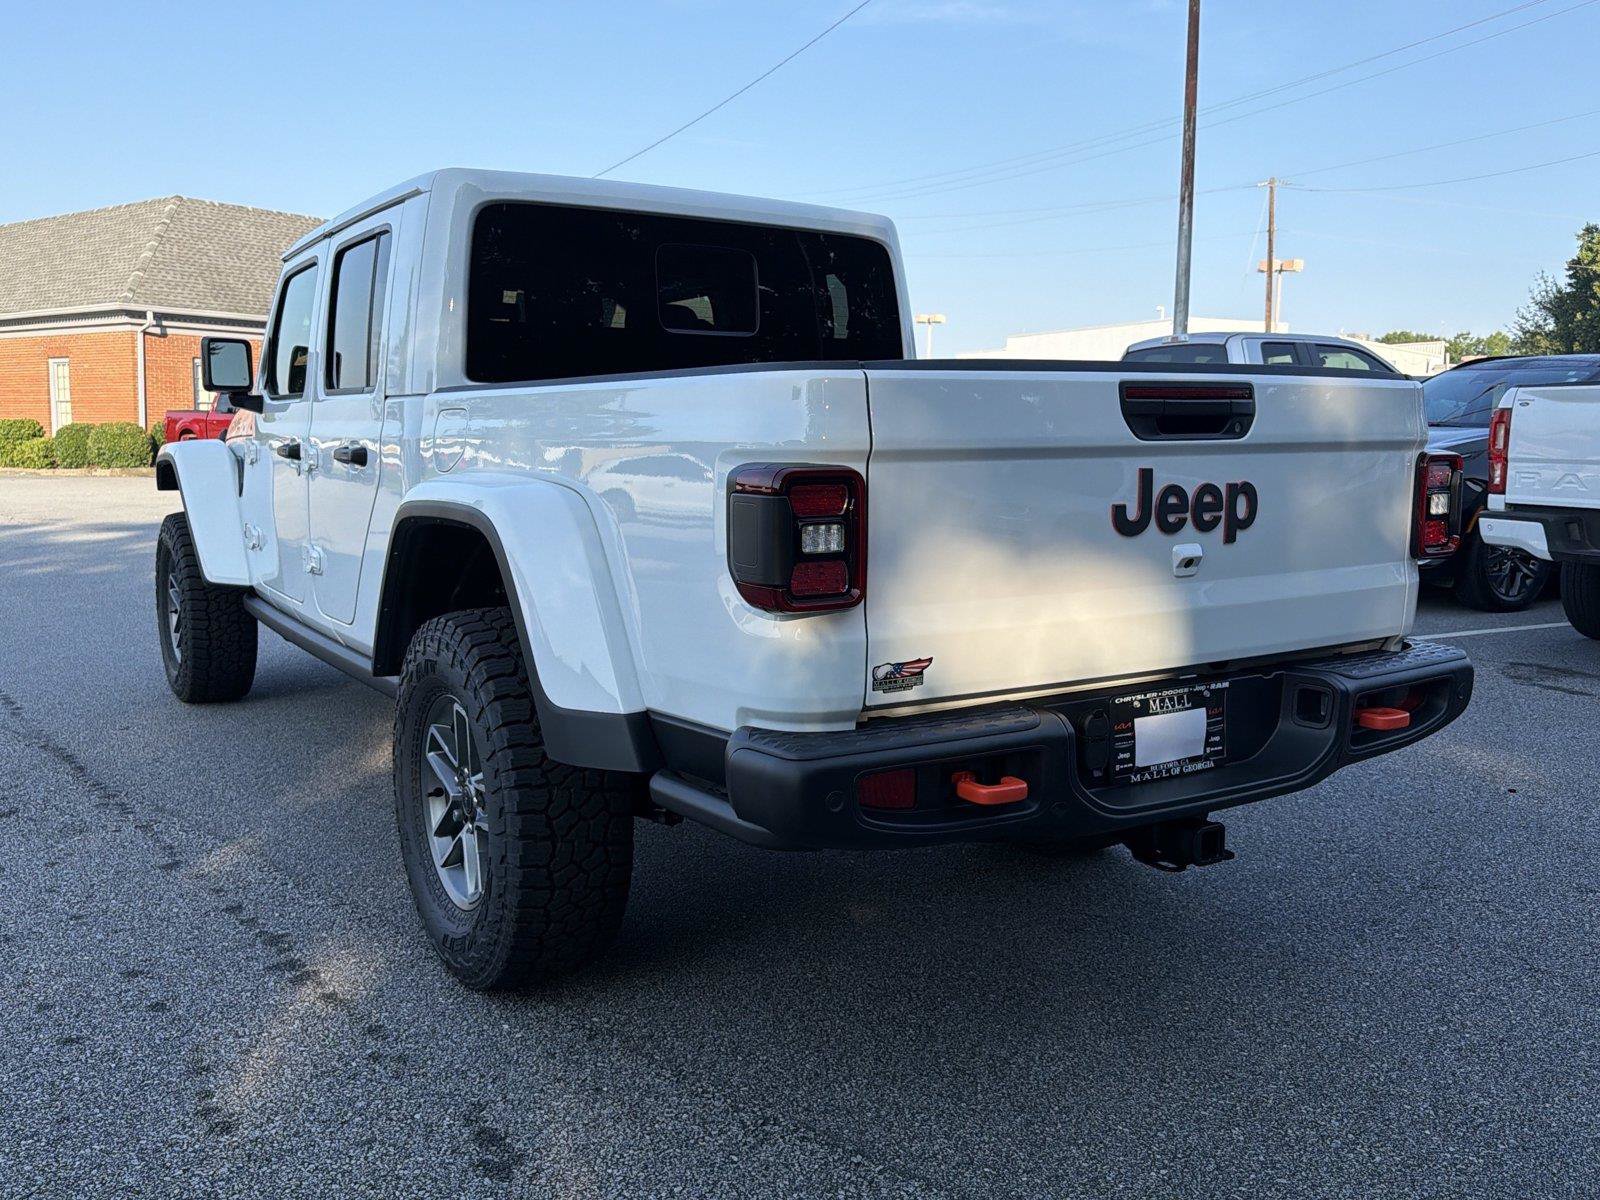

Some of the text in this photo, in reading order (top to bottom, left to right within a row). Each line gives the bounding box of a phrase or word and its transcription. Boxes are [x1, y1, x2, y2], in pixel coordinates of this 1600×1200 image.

[1110, 467, 1259, 544] Jeep
[1115, 693, 1158, 704] CHRYSLER
[1161, 688, 1189, 696] DODGE
[1171, 767, 1181, 776] OF
[1183, 760, 1215, 773] GEORGIA
